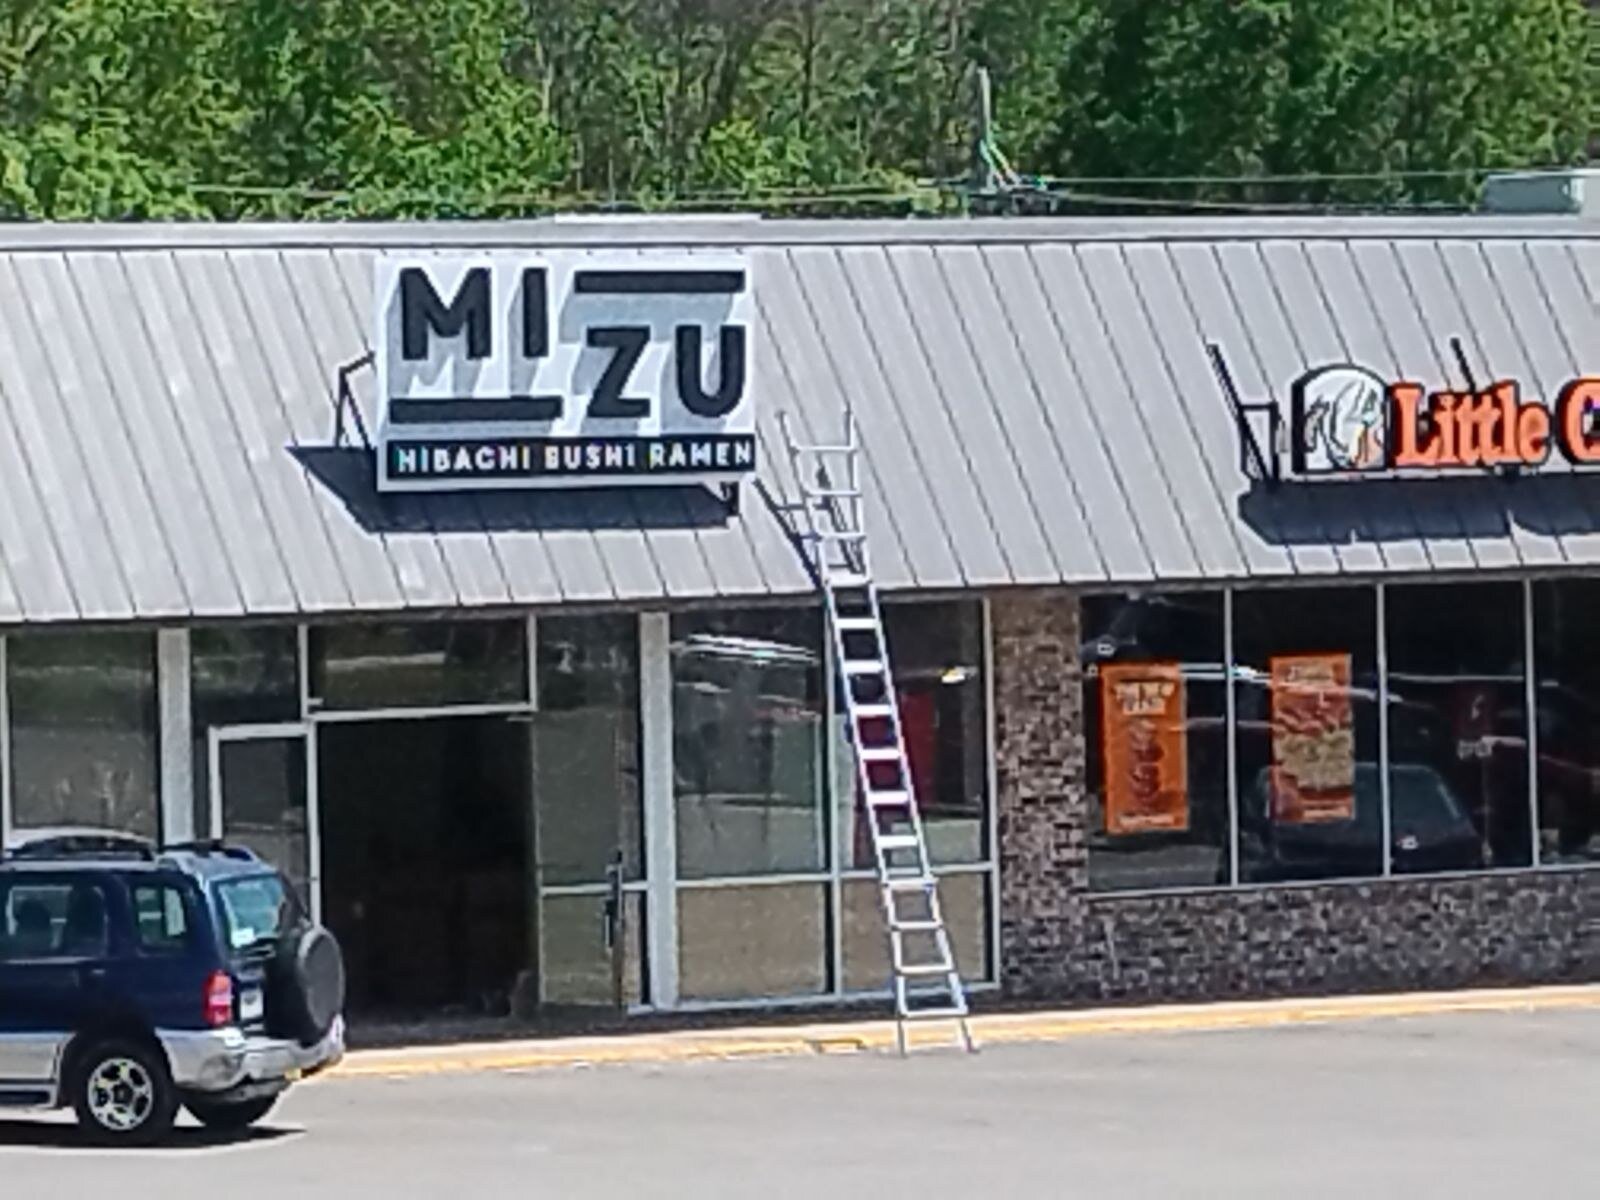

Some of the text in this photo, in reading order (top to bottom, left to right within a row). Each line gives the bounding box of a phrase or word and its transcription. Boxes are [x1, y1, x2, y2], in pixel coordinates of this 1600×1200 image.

[1388, 378, 1550, 468] Little
[397, 446, 531, 473] HIBACHI
[648, 440, 752, 468] RAMEN
